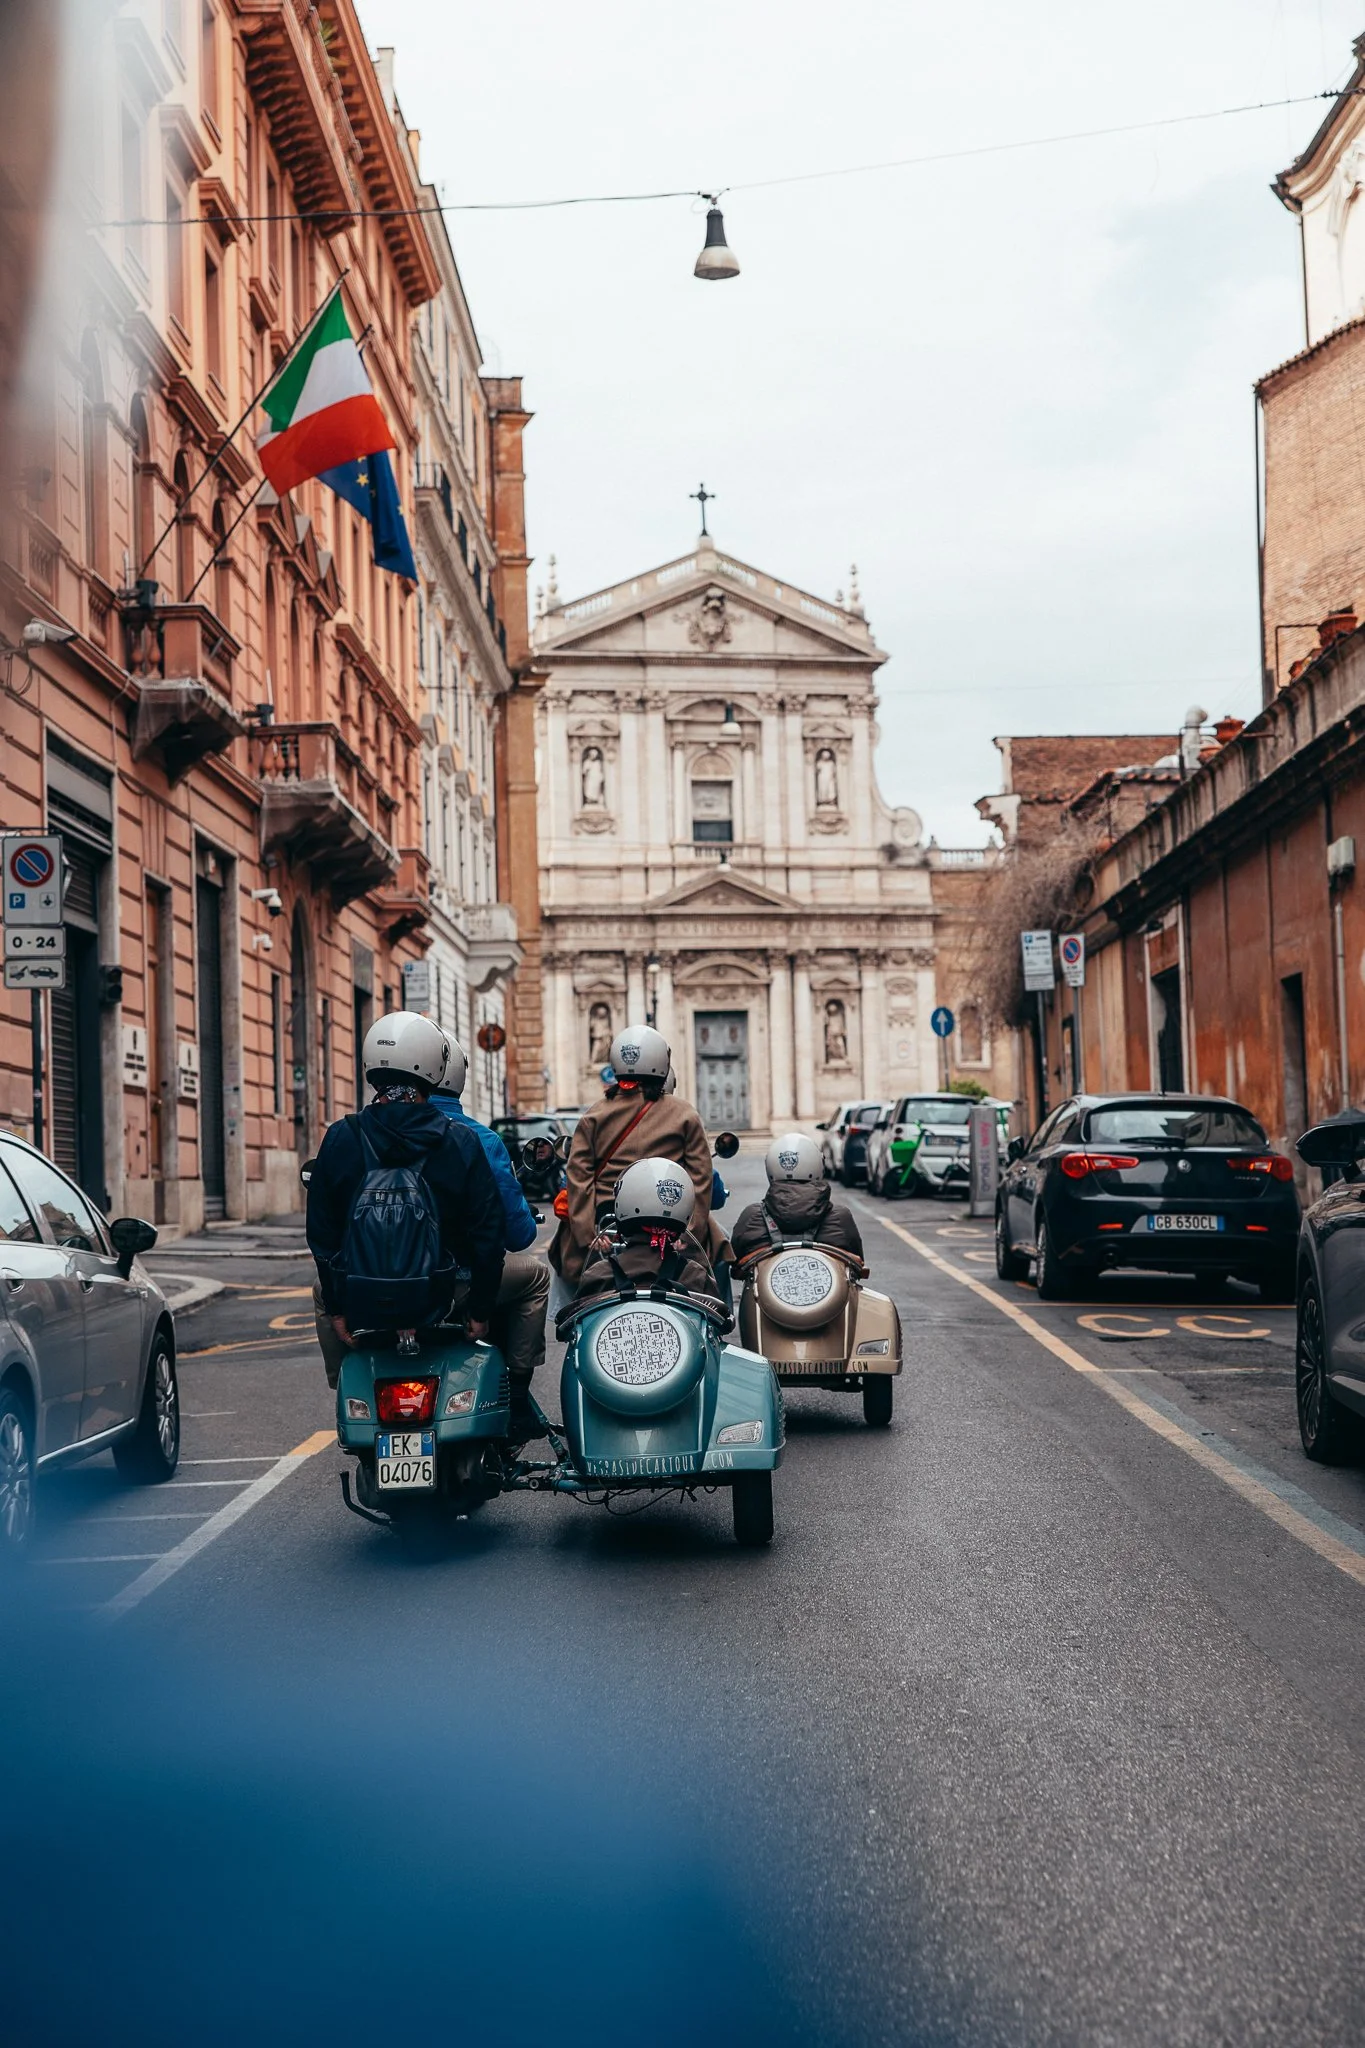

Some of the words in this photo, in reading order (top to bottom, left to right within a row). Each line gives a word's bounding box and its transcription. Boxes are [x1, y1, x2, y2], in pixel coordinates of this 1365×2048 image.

[12, 895, 22, 906] P
[12, 936, 23, 948] 0
[36, 936, 56, 948] 24
[1156, 1215, 1172, 1229] GB
[1176, 1215, 1216, 1229] 630CL
[391, 1434, 412, 1456] EK
[380, 1461, 432, 1484] 04076
